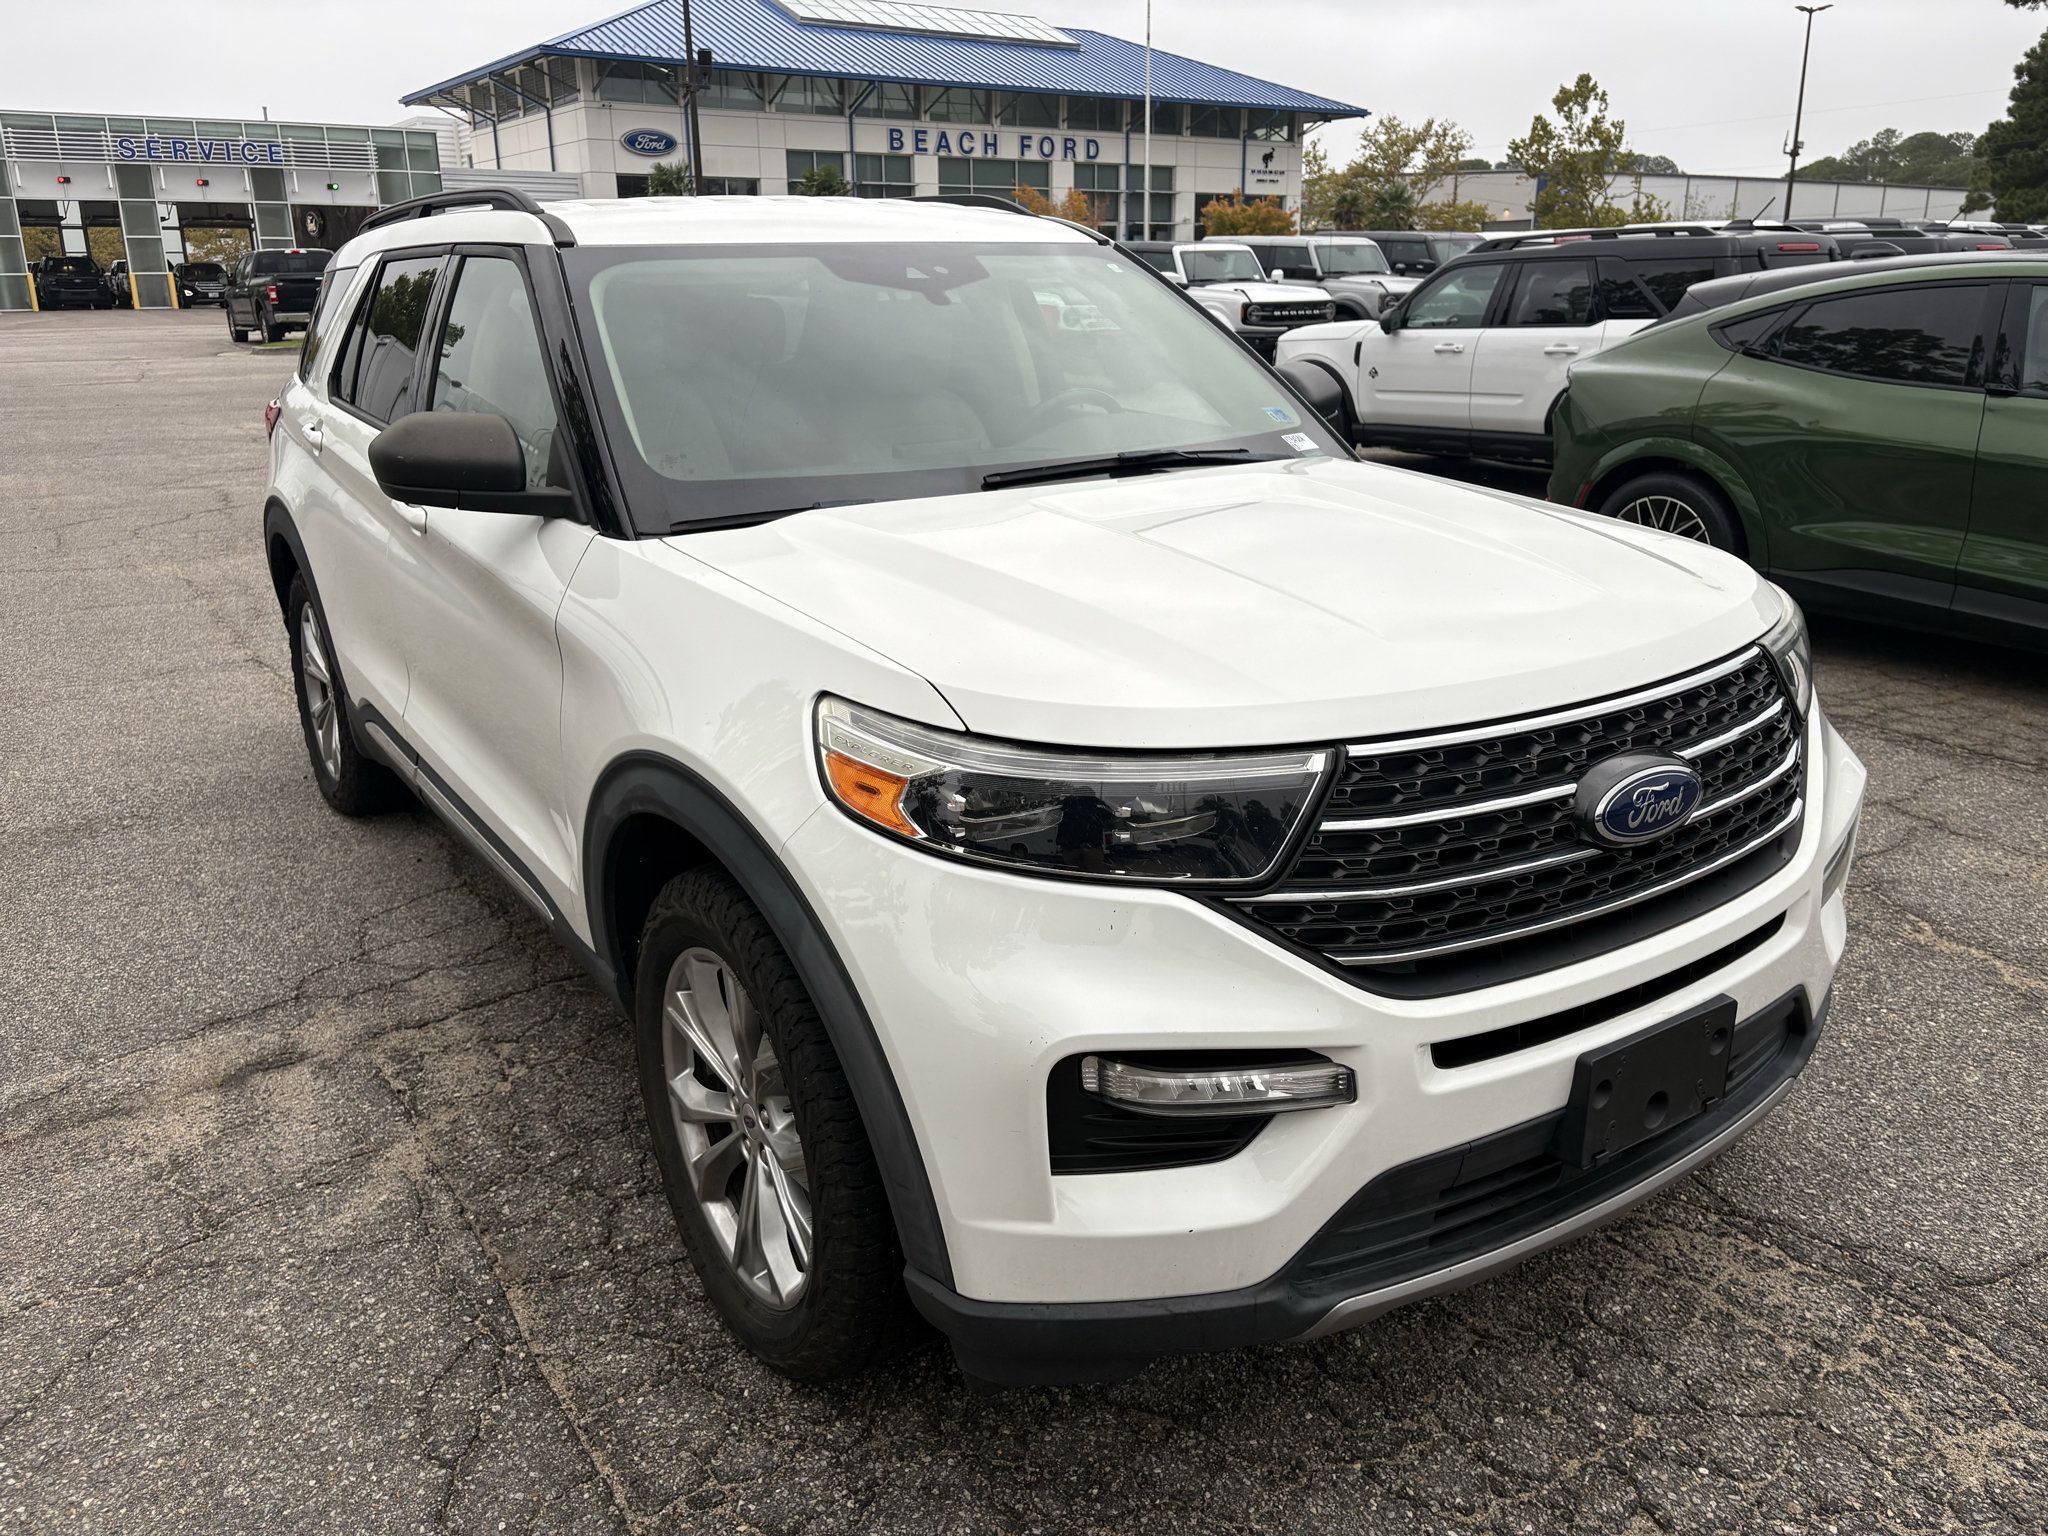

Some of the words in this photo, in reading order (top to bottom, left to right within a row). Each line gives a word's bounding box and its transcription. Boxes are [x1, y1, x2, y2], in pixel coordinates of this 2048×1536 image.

[118, 137, 284, 163] SERVICE
[635, 134, 667, 150] Ford
[889, 128, 998, 156] BEACH
[1019, 135, 1100, 160] FORD
[834, 735, 914, 772] EXPLORER
[1628, 781, 1684, 829] Ford
